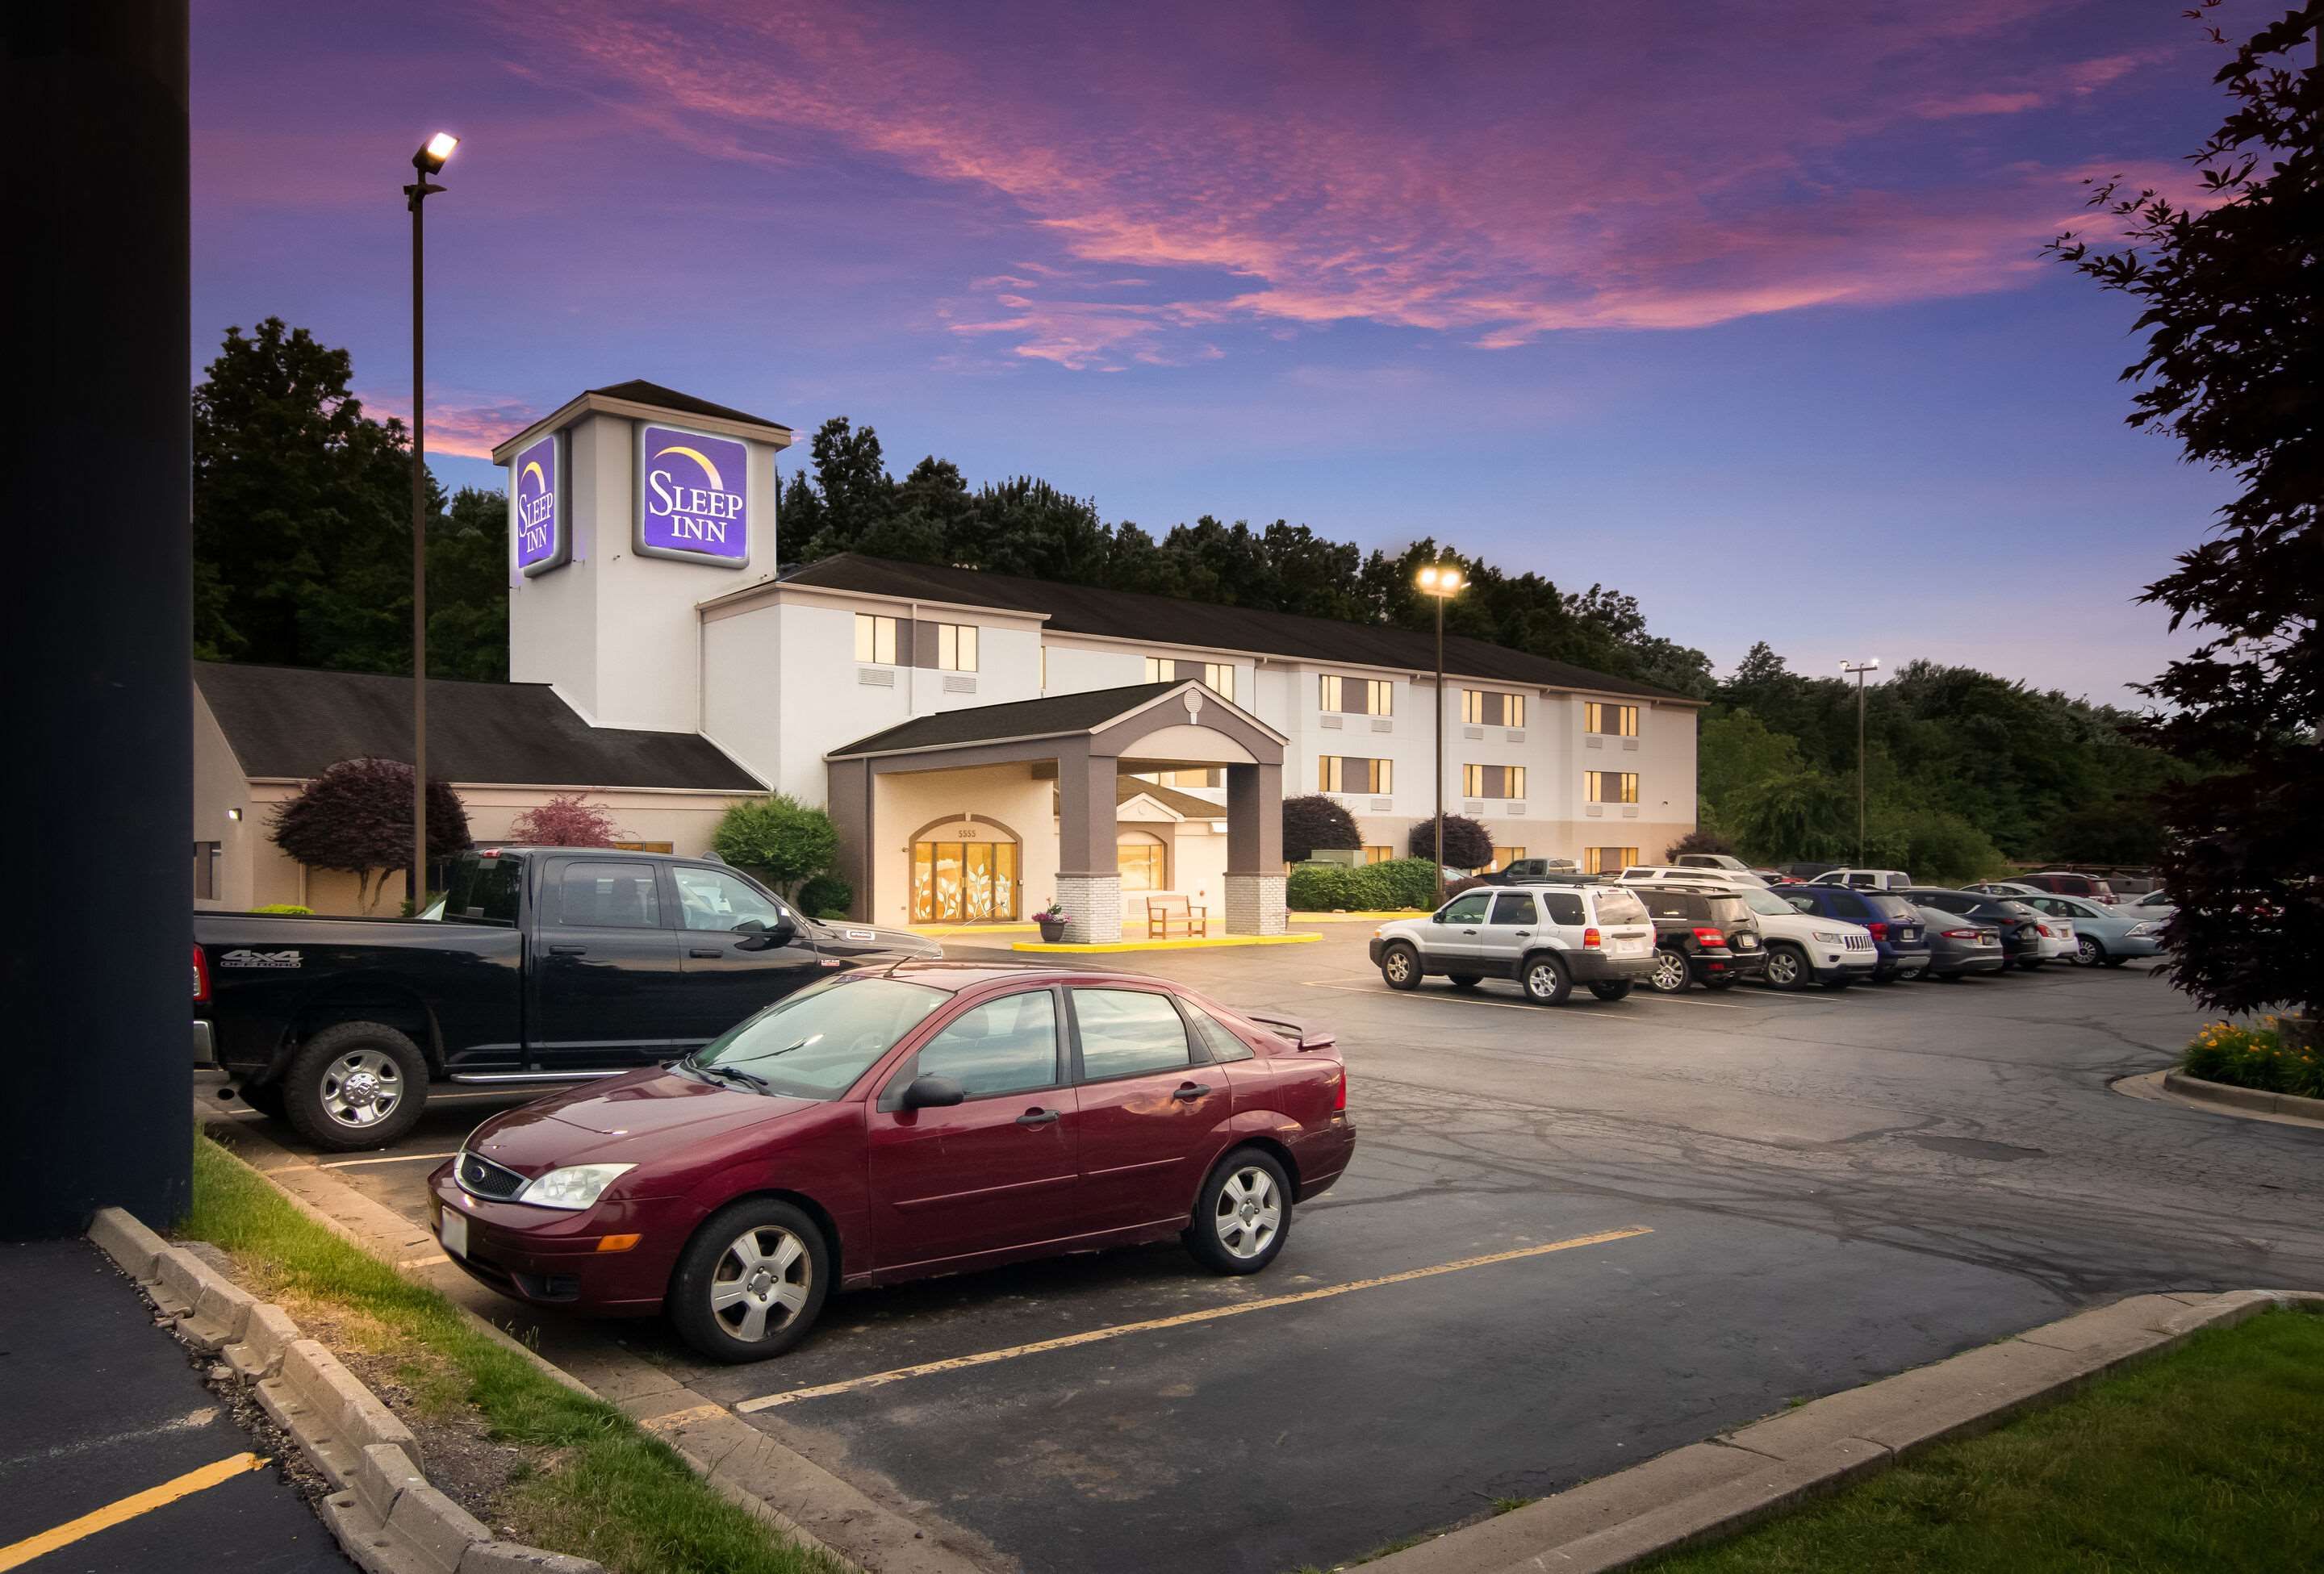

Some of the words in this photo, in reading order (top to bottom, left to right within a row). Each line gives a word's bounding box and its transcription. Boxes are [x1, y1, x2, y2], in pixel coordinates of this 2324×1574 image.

[649, 470, 743, 520] SLEEP
[519, 492, 554, 538] SLEEP
[671, 515, 728, 543] INN
[526, 524, 547, 553] INN
[958, 829, 976, 838] 5555
